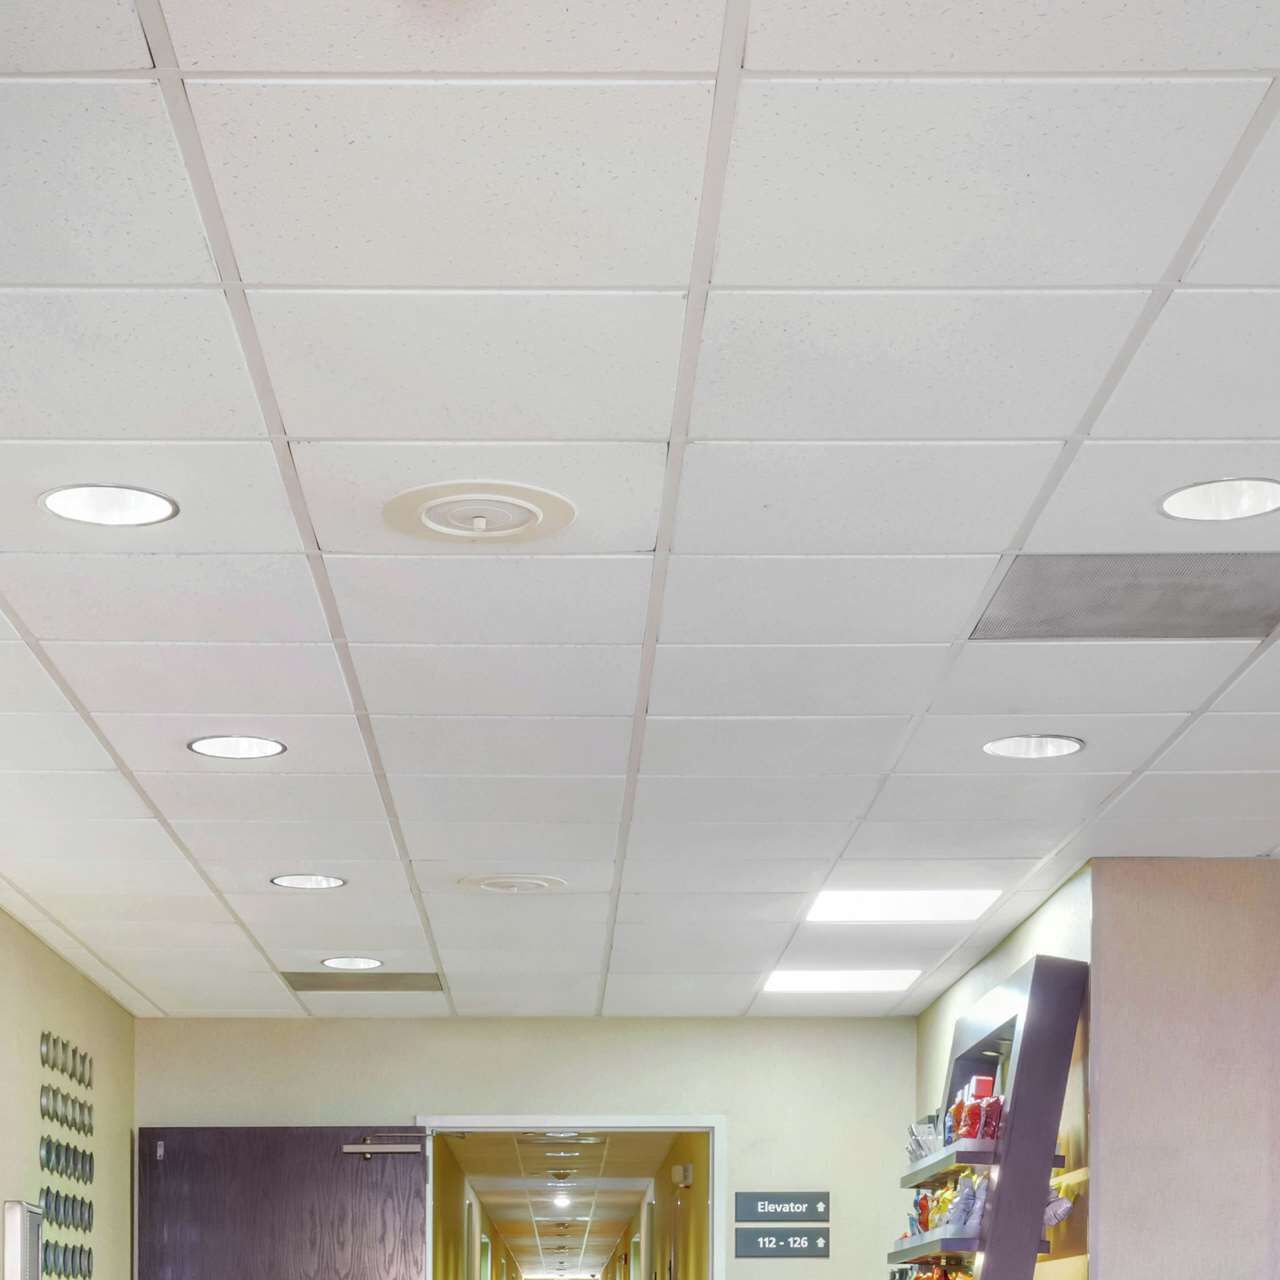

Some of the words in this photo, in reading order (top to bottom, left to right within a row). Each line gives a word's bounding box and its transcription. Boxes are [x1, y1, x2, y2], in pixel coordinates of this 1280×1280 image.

[757, 1200, 808, 1212] Elevator
[757, 1236, 777, 1248] 112
[787, 1236, 808, 1248] 126
